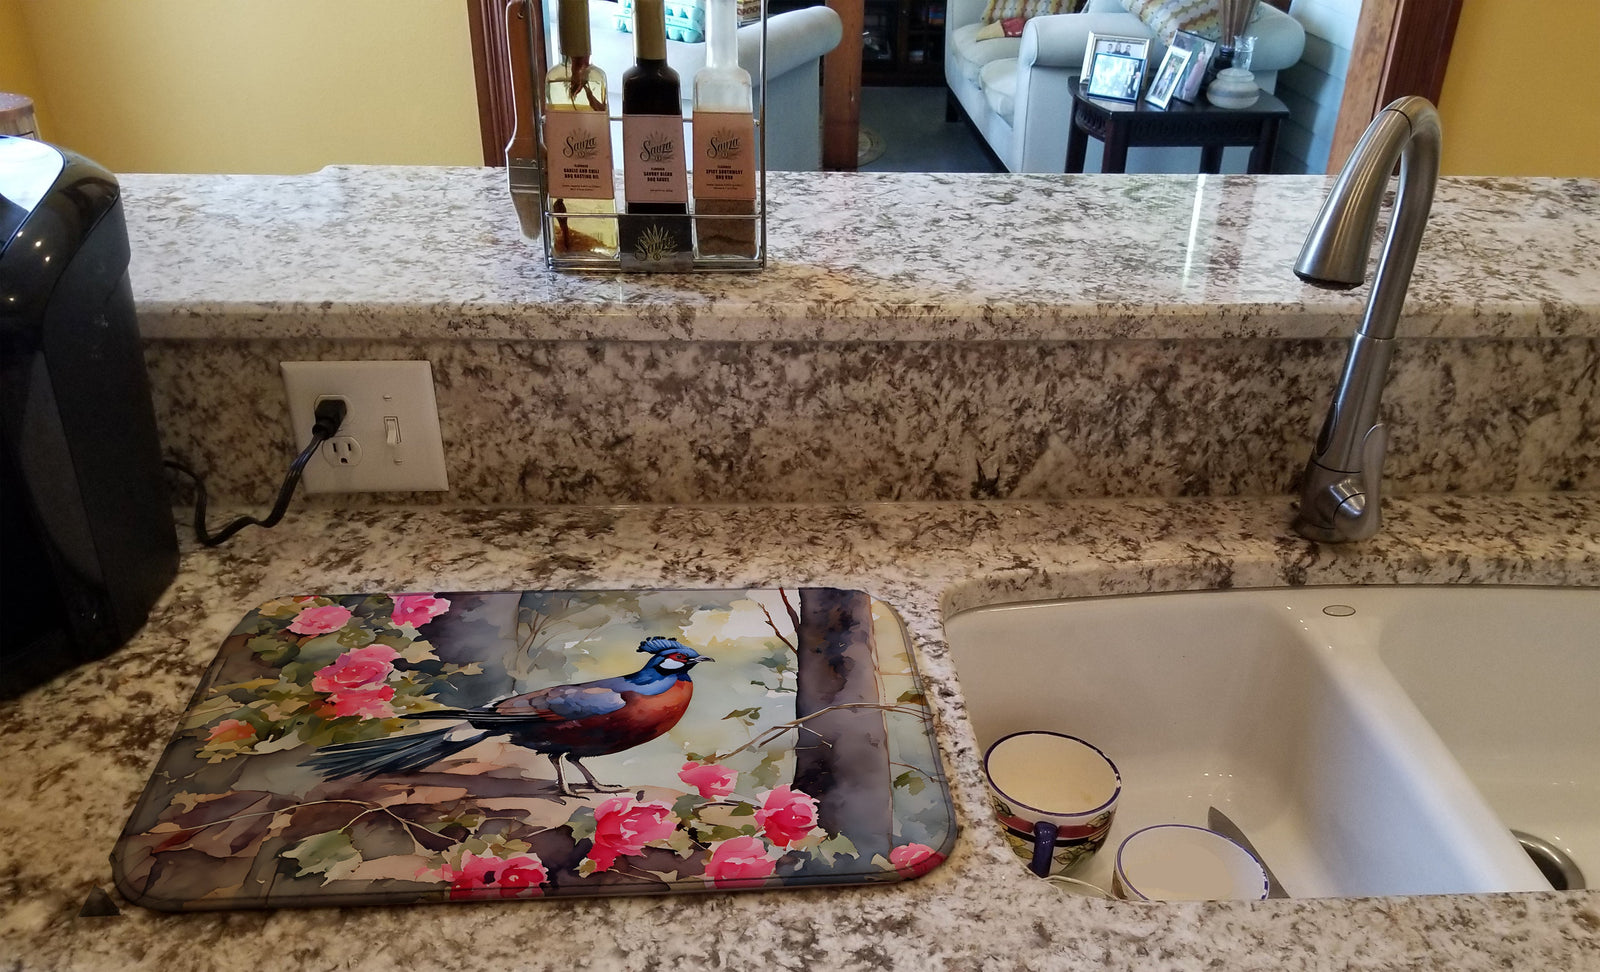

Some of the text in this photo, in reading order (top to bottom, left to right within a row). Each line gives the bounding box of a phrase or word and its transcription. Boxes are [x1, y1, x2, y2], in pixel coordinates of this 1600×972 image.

[563, 136, 597, 158] Sauza
[640, 140, 674, 161] Sauza
[707, 136, 740, 158] Sauza
